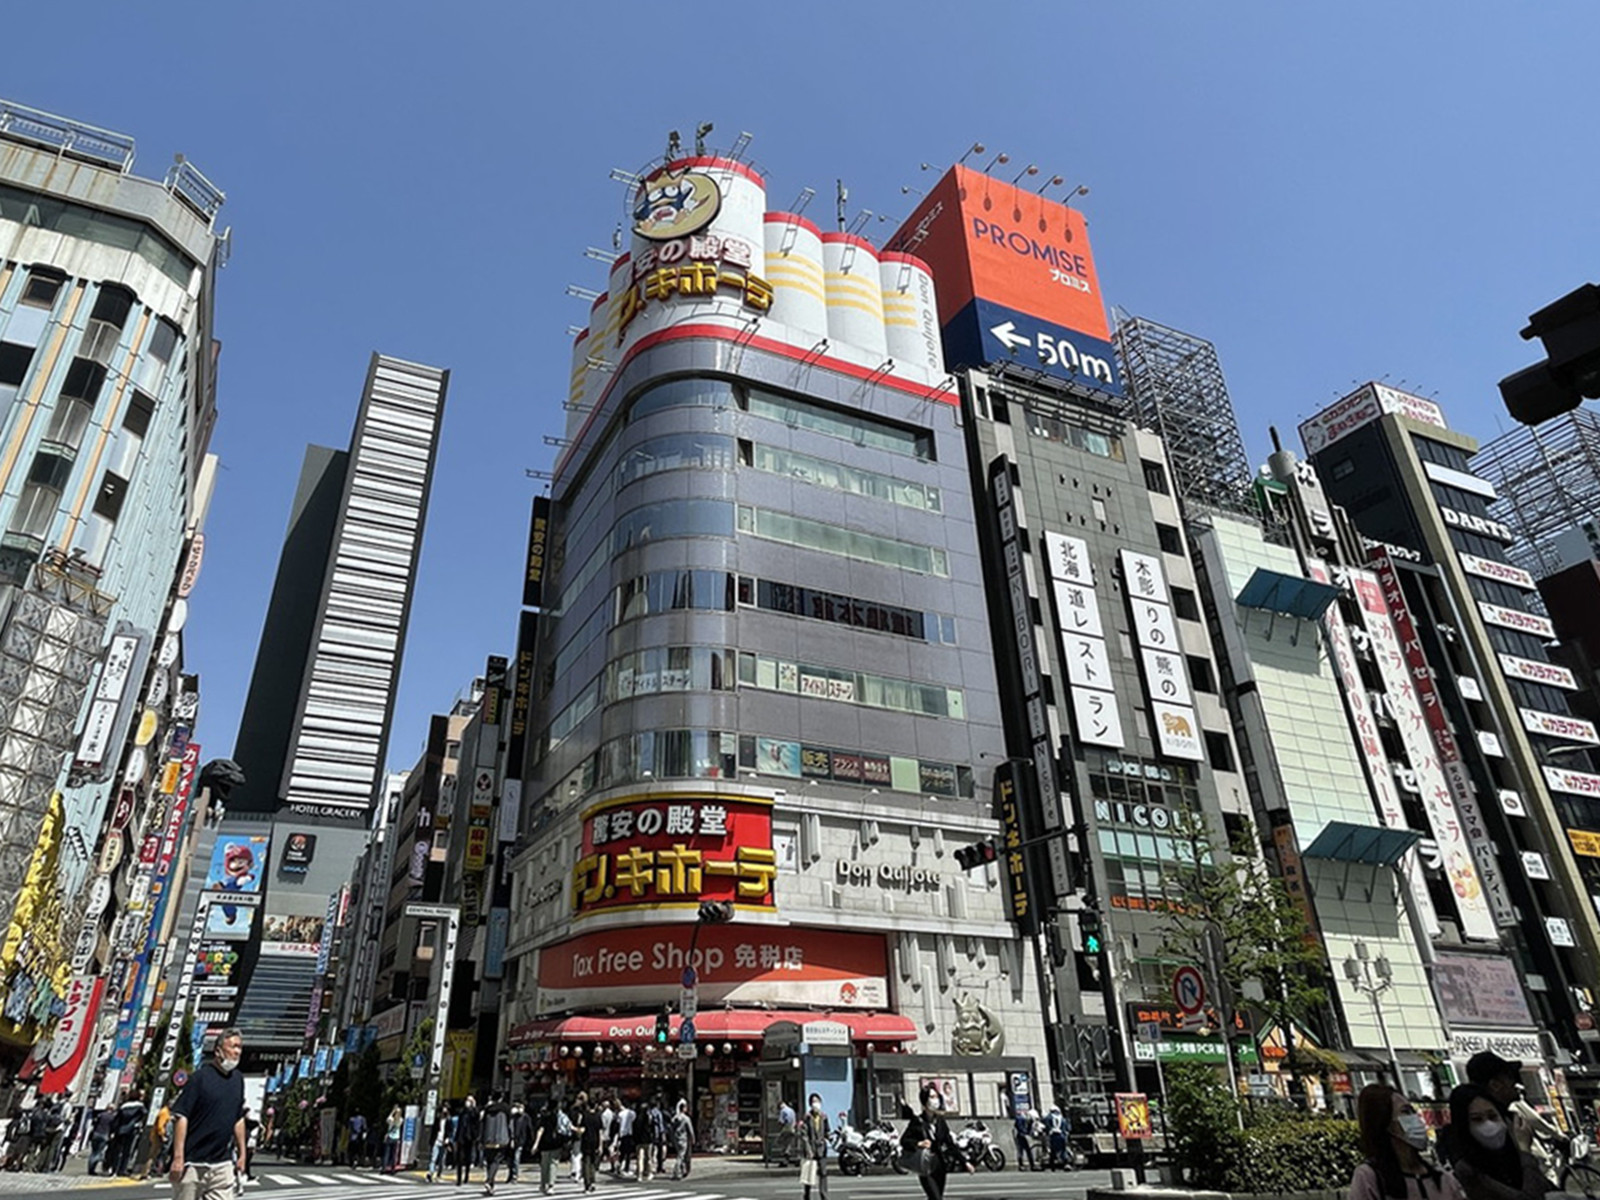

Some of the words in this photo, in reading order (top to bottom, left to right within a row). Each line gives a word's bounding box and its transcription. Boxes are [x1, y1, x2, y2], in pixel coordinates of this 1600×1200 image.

[973, 217, 1087, 278] PROMISE
[917, 273, 930, 306] Don
[1050, 269, 1092, 294] プロミス
[922, 310, 938, 370] Quijote
[1037, 332, 1113, 385] 50m
[1440, 506, 1512, 541] DARTS
[1059, 540, 1109, 738] 北海道レストラン
[1135, 558, 1177, 697] 木彫りの熊の
[290, 803, 319, 815] HOTEL
[320, 806, 362, 818] GRACERY
[592, 805, 728, 845] 驚安の殿堂
[837, 860, 873, 885] Don
[879, 862, 941, 891] Quijote
[572, 953, 593, 978] Tax
[597, 948, 644, 973] Free
[652, 942, 724, 975] Shop
[734, 943, 803, 971] 免税店
[609, 1026, 633, 1037] Don
[635, 1026, 679, 1037] Quie
